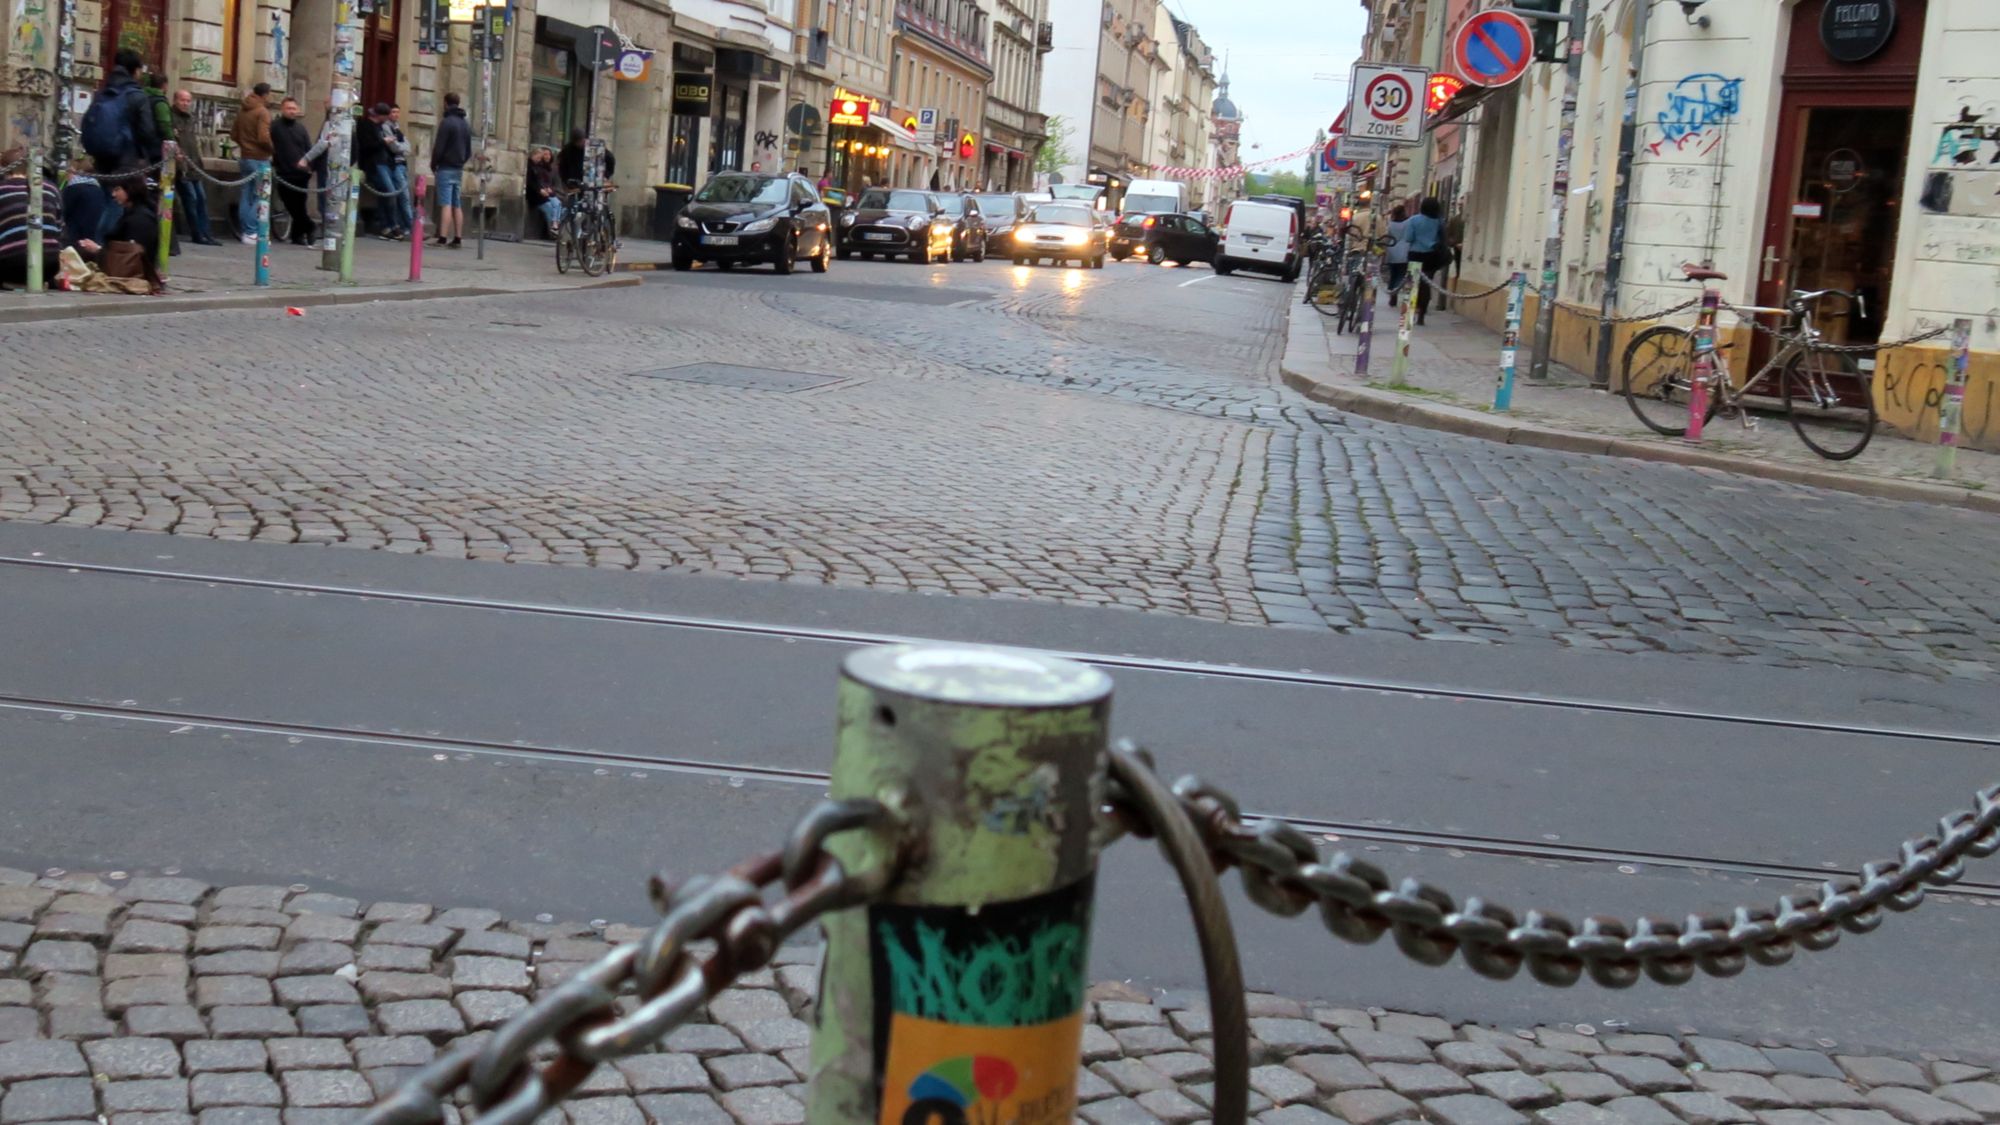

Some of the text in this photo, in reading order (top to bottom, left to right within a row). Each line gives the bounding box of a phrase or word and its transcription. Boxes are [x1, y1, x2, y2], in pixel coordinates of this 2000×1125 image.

[676, 84, 709, 102] LOBO
[1374, 86, 1403, 109] 30
[1367, 122, 1403, 136] ZONE
